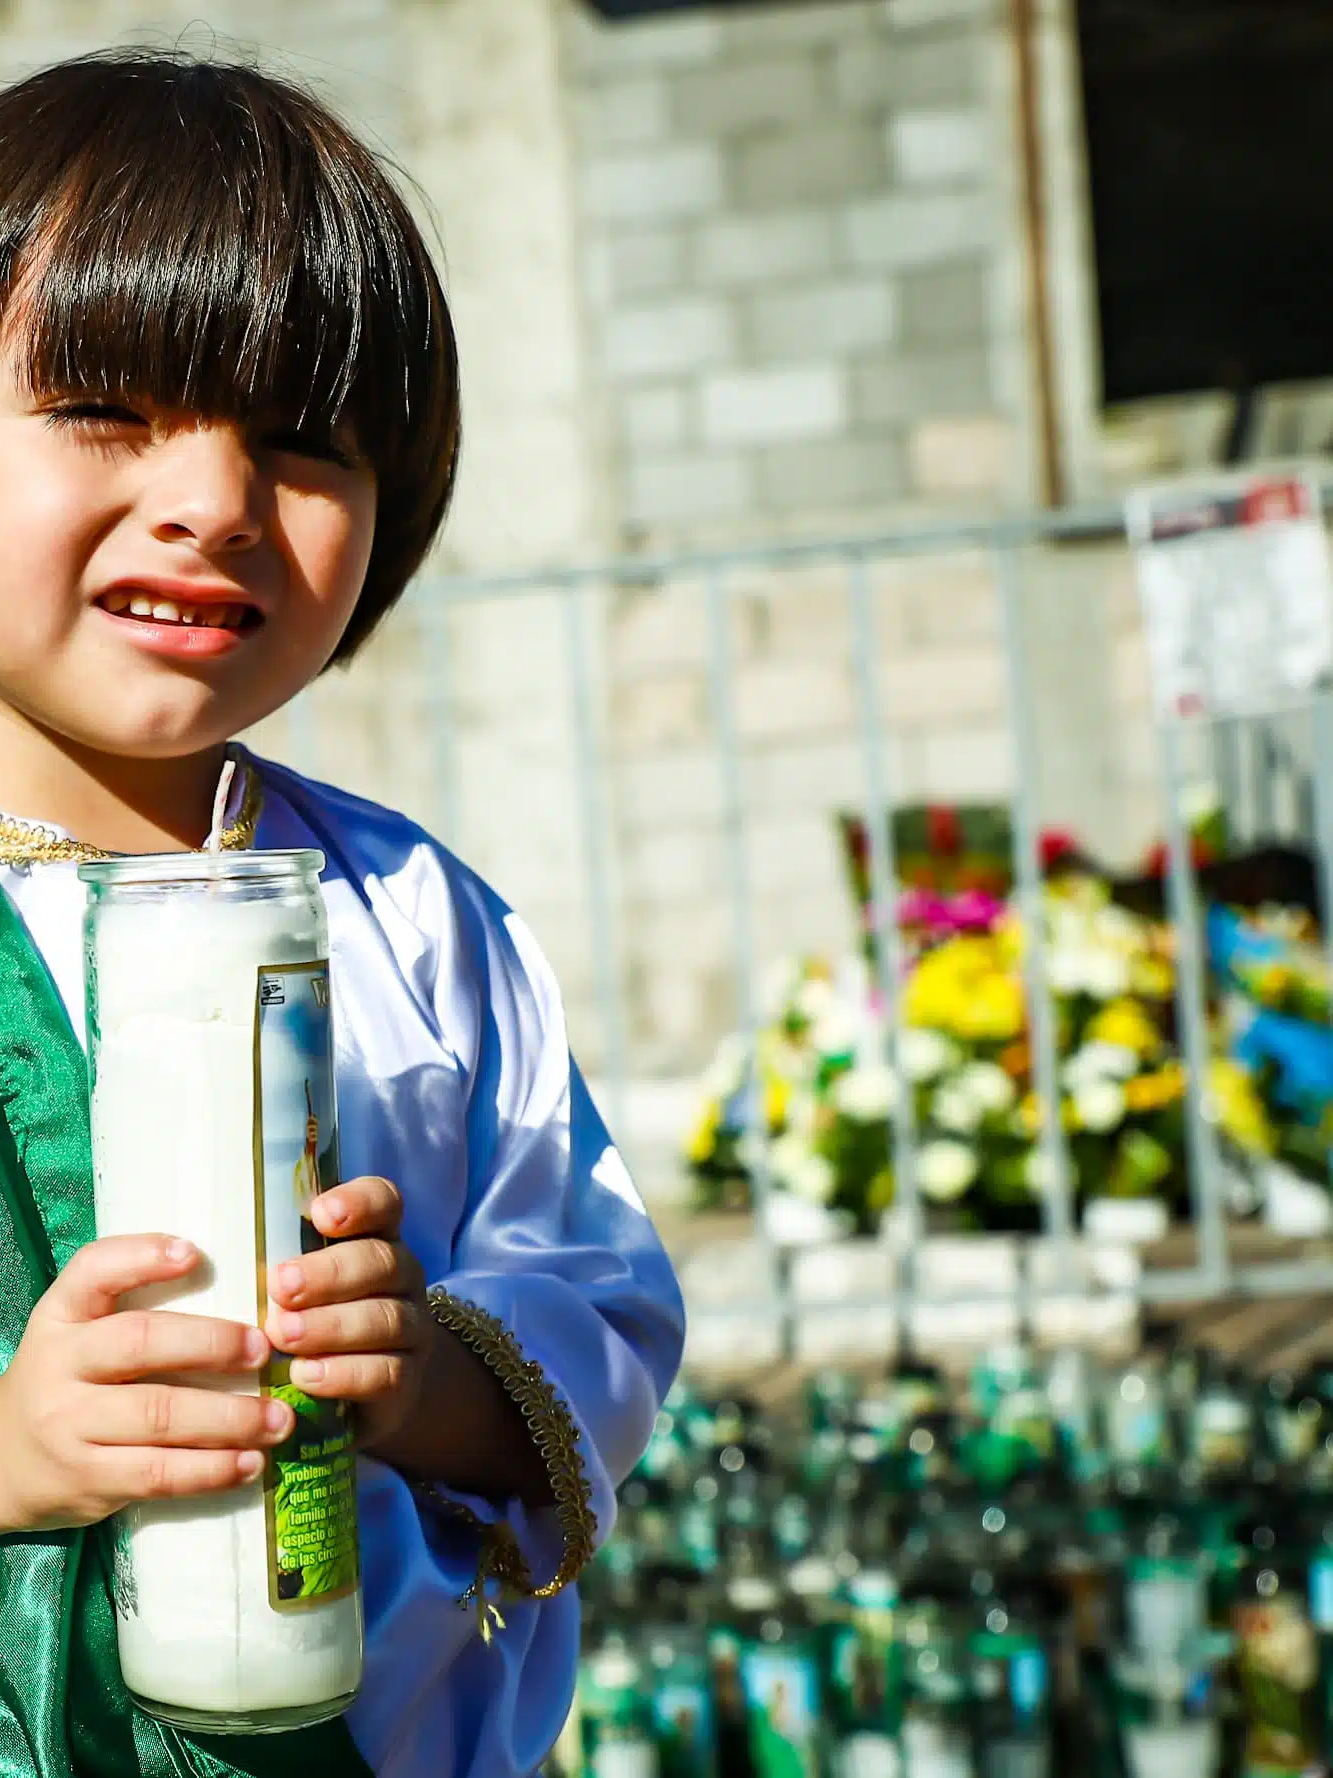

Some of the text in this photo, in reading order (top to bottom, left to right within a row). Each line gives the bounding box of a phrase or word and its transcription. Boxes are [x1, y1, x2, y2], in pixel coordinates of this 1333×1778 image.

[289, 1489, 309, 1506] que
[290, 1506, 326, 1525] familia
[283, 1528, 325, 1548] aspecto
[281, 1554, 296, 1570] de
[299, 1552, 315, 1567] las
